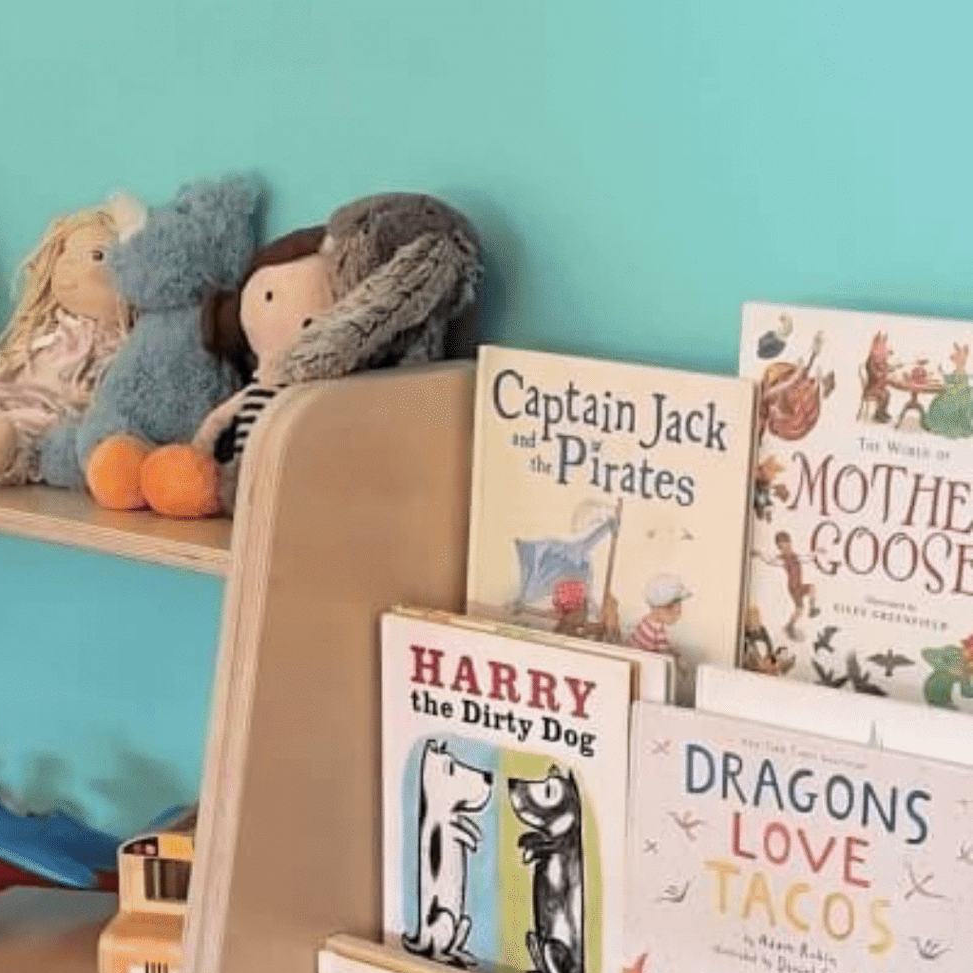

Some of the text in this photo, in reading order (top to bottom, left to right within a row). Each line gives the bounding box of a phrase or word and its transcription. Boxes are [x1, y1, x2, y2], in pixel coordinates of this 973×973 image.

[493, 369, 728, 451] Captain Jack
[512, 430, 536, 449] and
[556, 433, 695, 507] Pirates
[410, 645, 597, 719] HARRY
[411, 690, 597, 757] the Dirty Dog
[685, 744, 932, 845] DRAGONS
[732, 811, 871, 889] LOVE
[703, 859, 895, 955] TACOS
